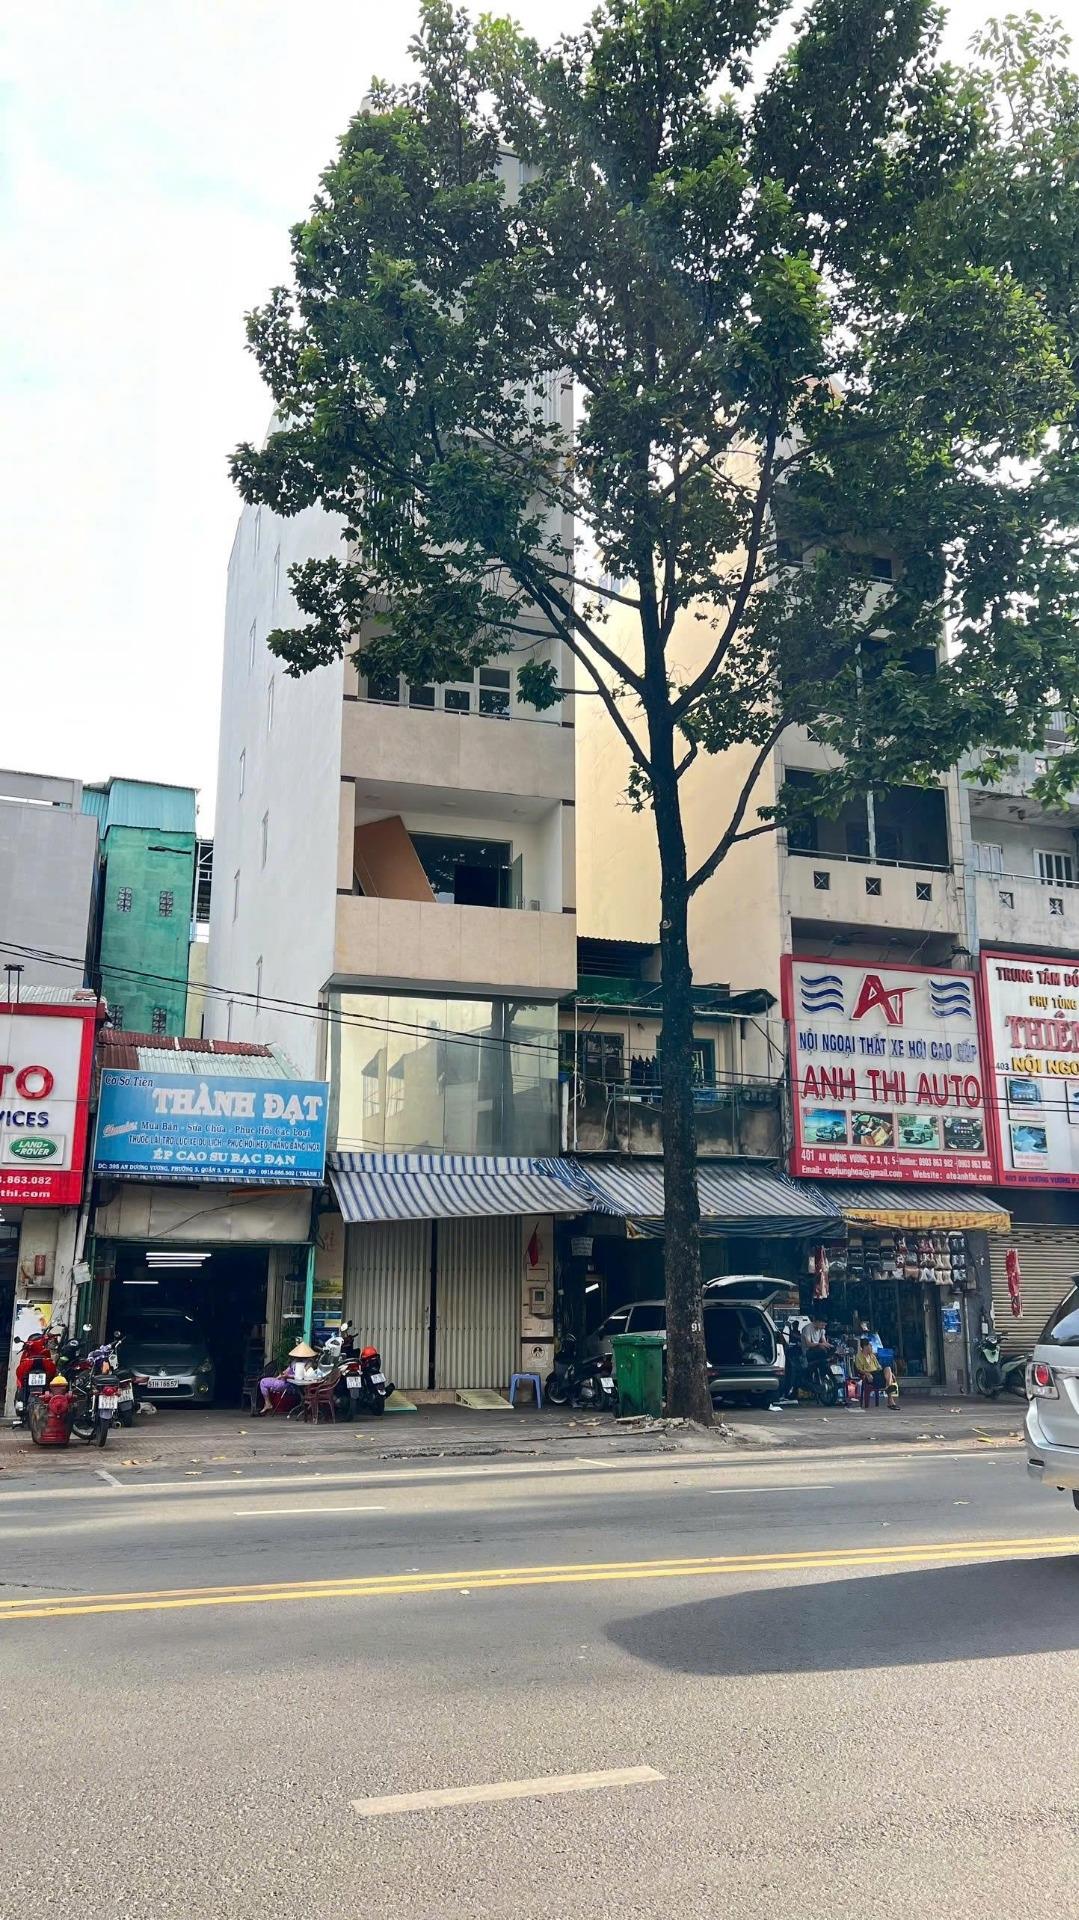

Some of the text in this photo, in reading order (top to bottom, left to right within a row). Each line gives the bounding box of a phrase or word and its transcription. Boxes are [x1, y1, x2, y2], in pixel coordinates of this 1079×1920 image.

[995, 967, 1034, 984] TRUNG
[1037, 968, 1060, 986] TÂM
[1029, 994, 1077, 1011] PHỤ TÙNG
[799, 1028, 818, 1056] NỘI
[822, 1033, 856, 1058] NGOẠI
[859, 1033, 886, 1057] THẤT
[890, 1039, 904, 1058] XE
[908, 1038, 928, 1059] HƠI
[930, 1041, 952, 1062] CAO
[1011, 1054, 1043, 1077] NỘI
[801, 1064, 982, 1109] ANH THI AUTO
[152, 1082, 323, 1126] THÀNH ĐẠT
[141, 1121, 159, 1131] Mua
[19, 1139, 44, 1148] LAND
[21, 1147, 50, 1156] ROVER
[152, 1147, 173, 1160] ÉP
[175, 1150, 207, 1161] CAO
[209, 1152, 228, 1162] SU
[230, 1153, 261, 1165] BẠC
[801, 1149, 814, 1161] 401
[801, 1165, 822, 1175] Email:
[912, 1170, 943, 1180] Website:
